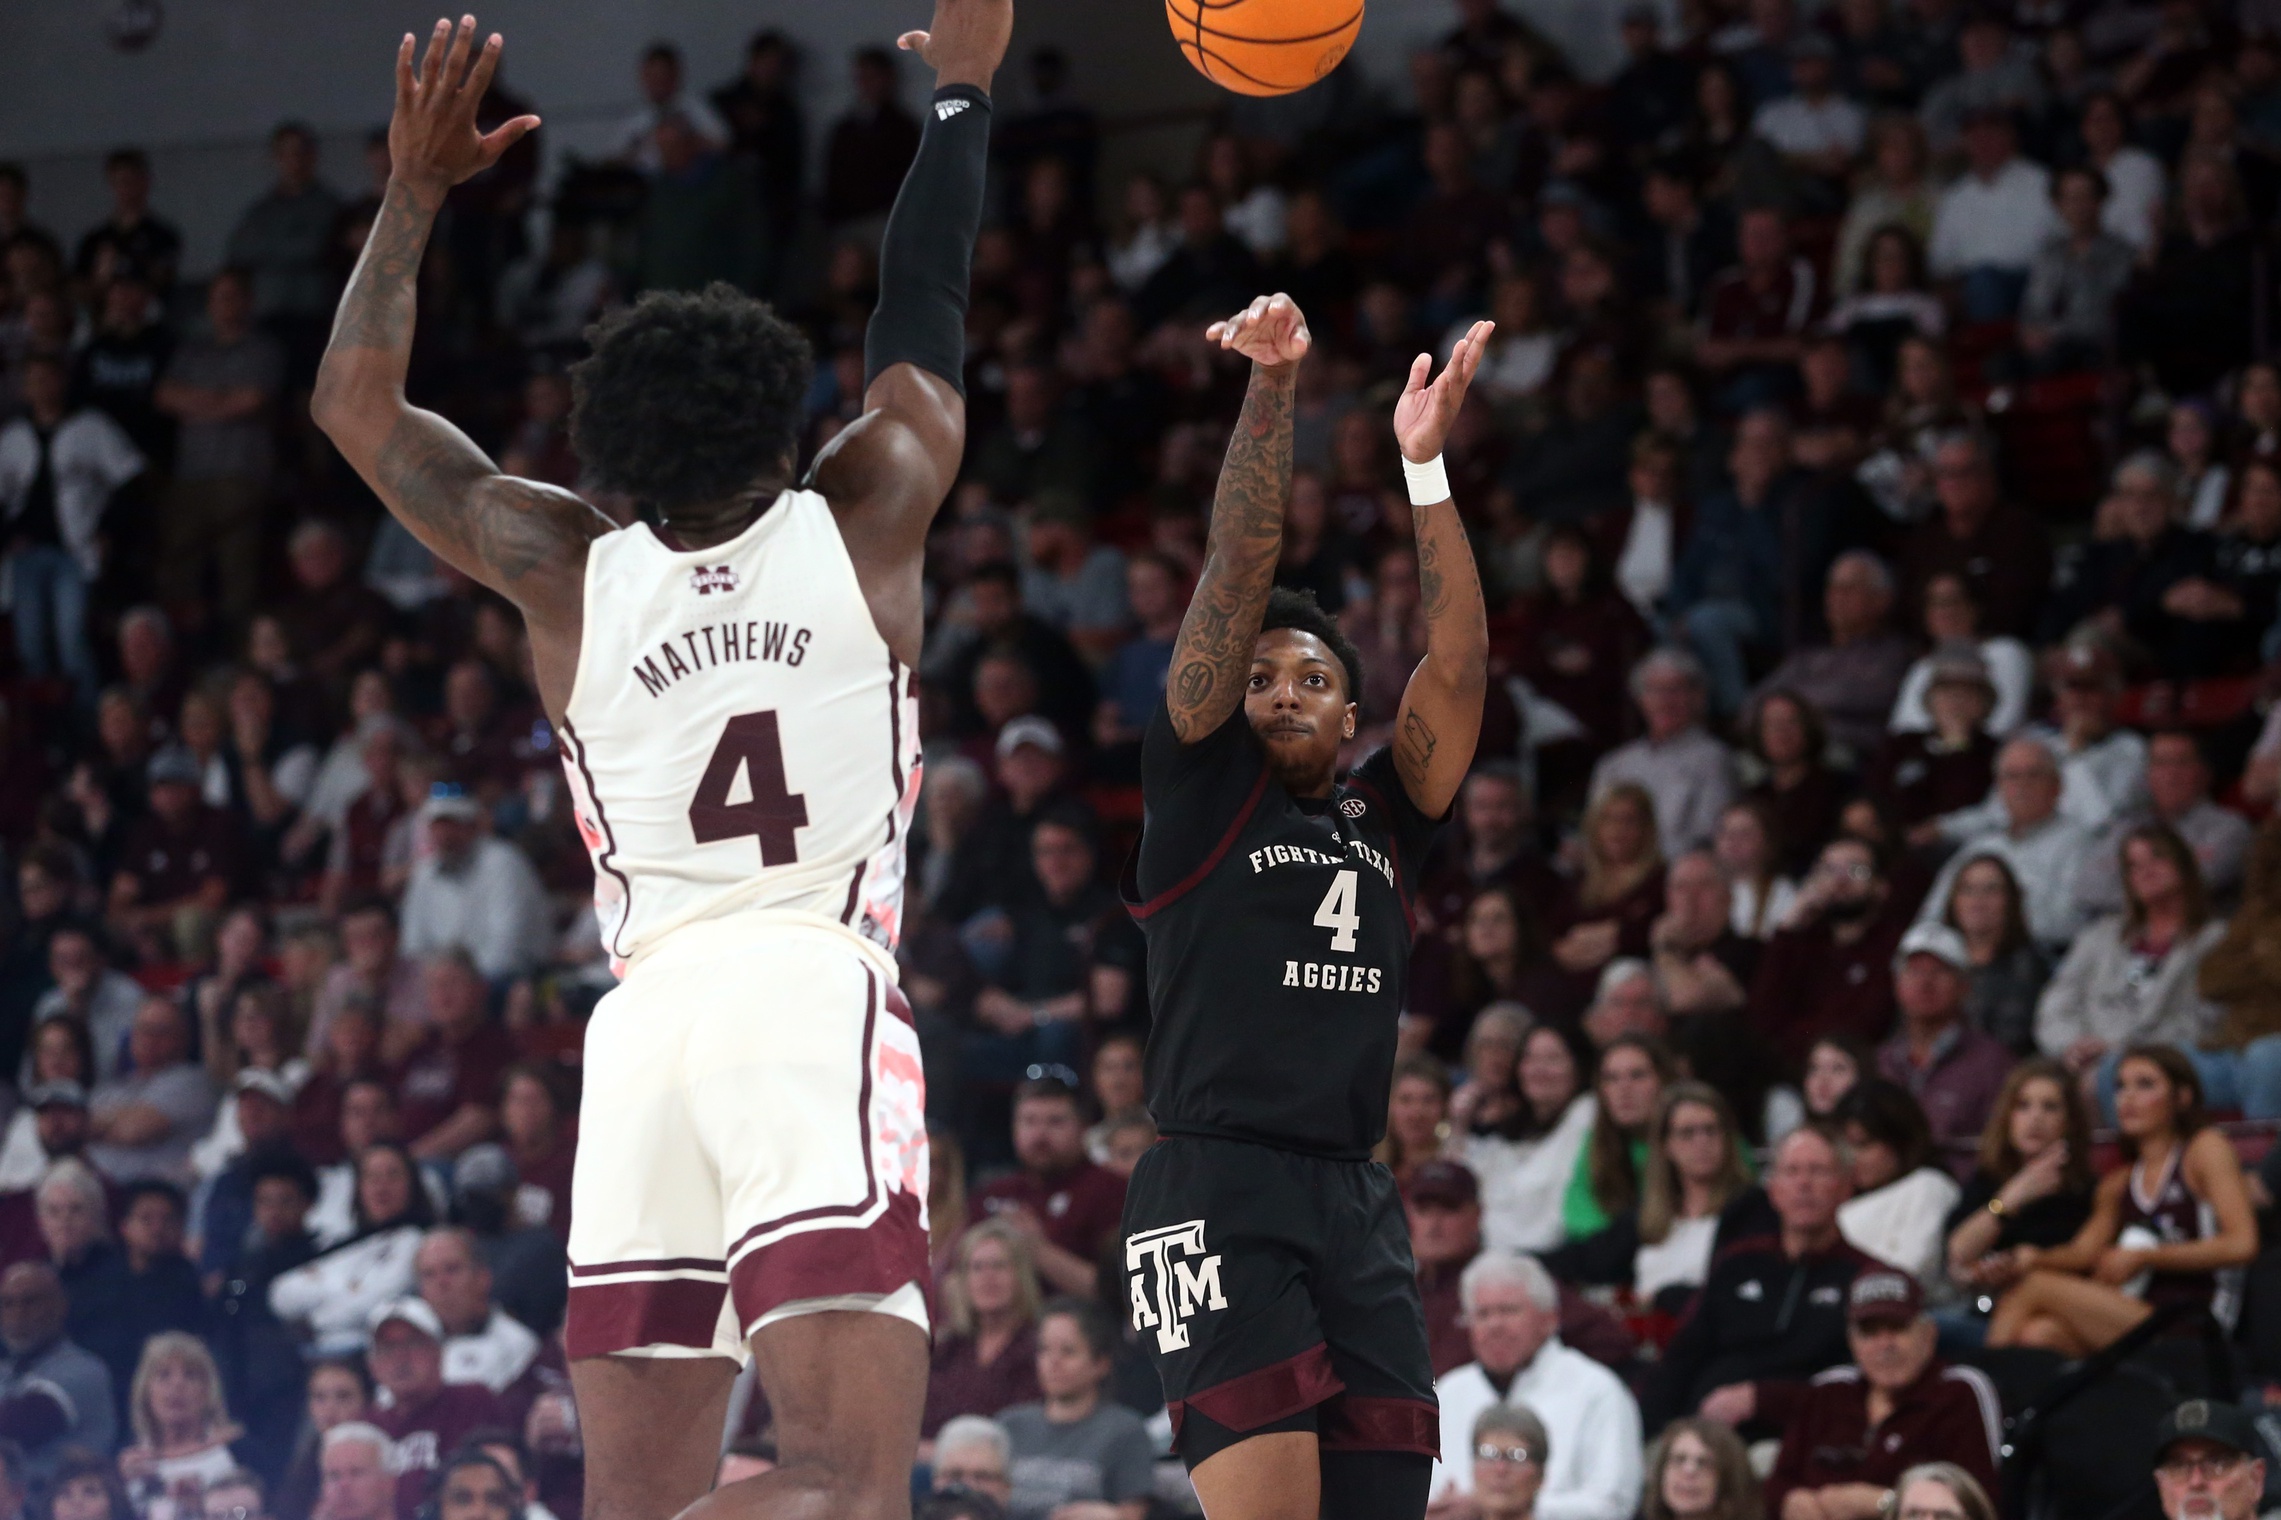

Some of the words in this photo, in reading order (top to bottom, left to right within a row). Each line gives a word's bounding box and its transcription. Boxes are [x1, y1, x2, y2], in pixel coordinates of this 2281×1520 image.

[632, 621, 812, 699] MATTHEWS
[688, 709, 809, 868] 4
[1340, 799, 1366, 818] SEC
[1313, 869, 1360, 953] 4
[1282, 960, 1382, 994] AGGIES
